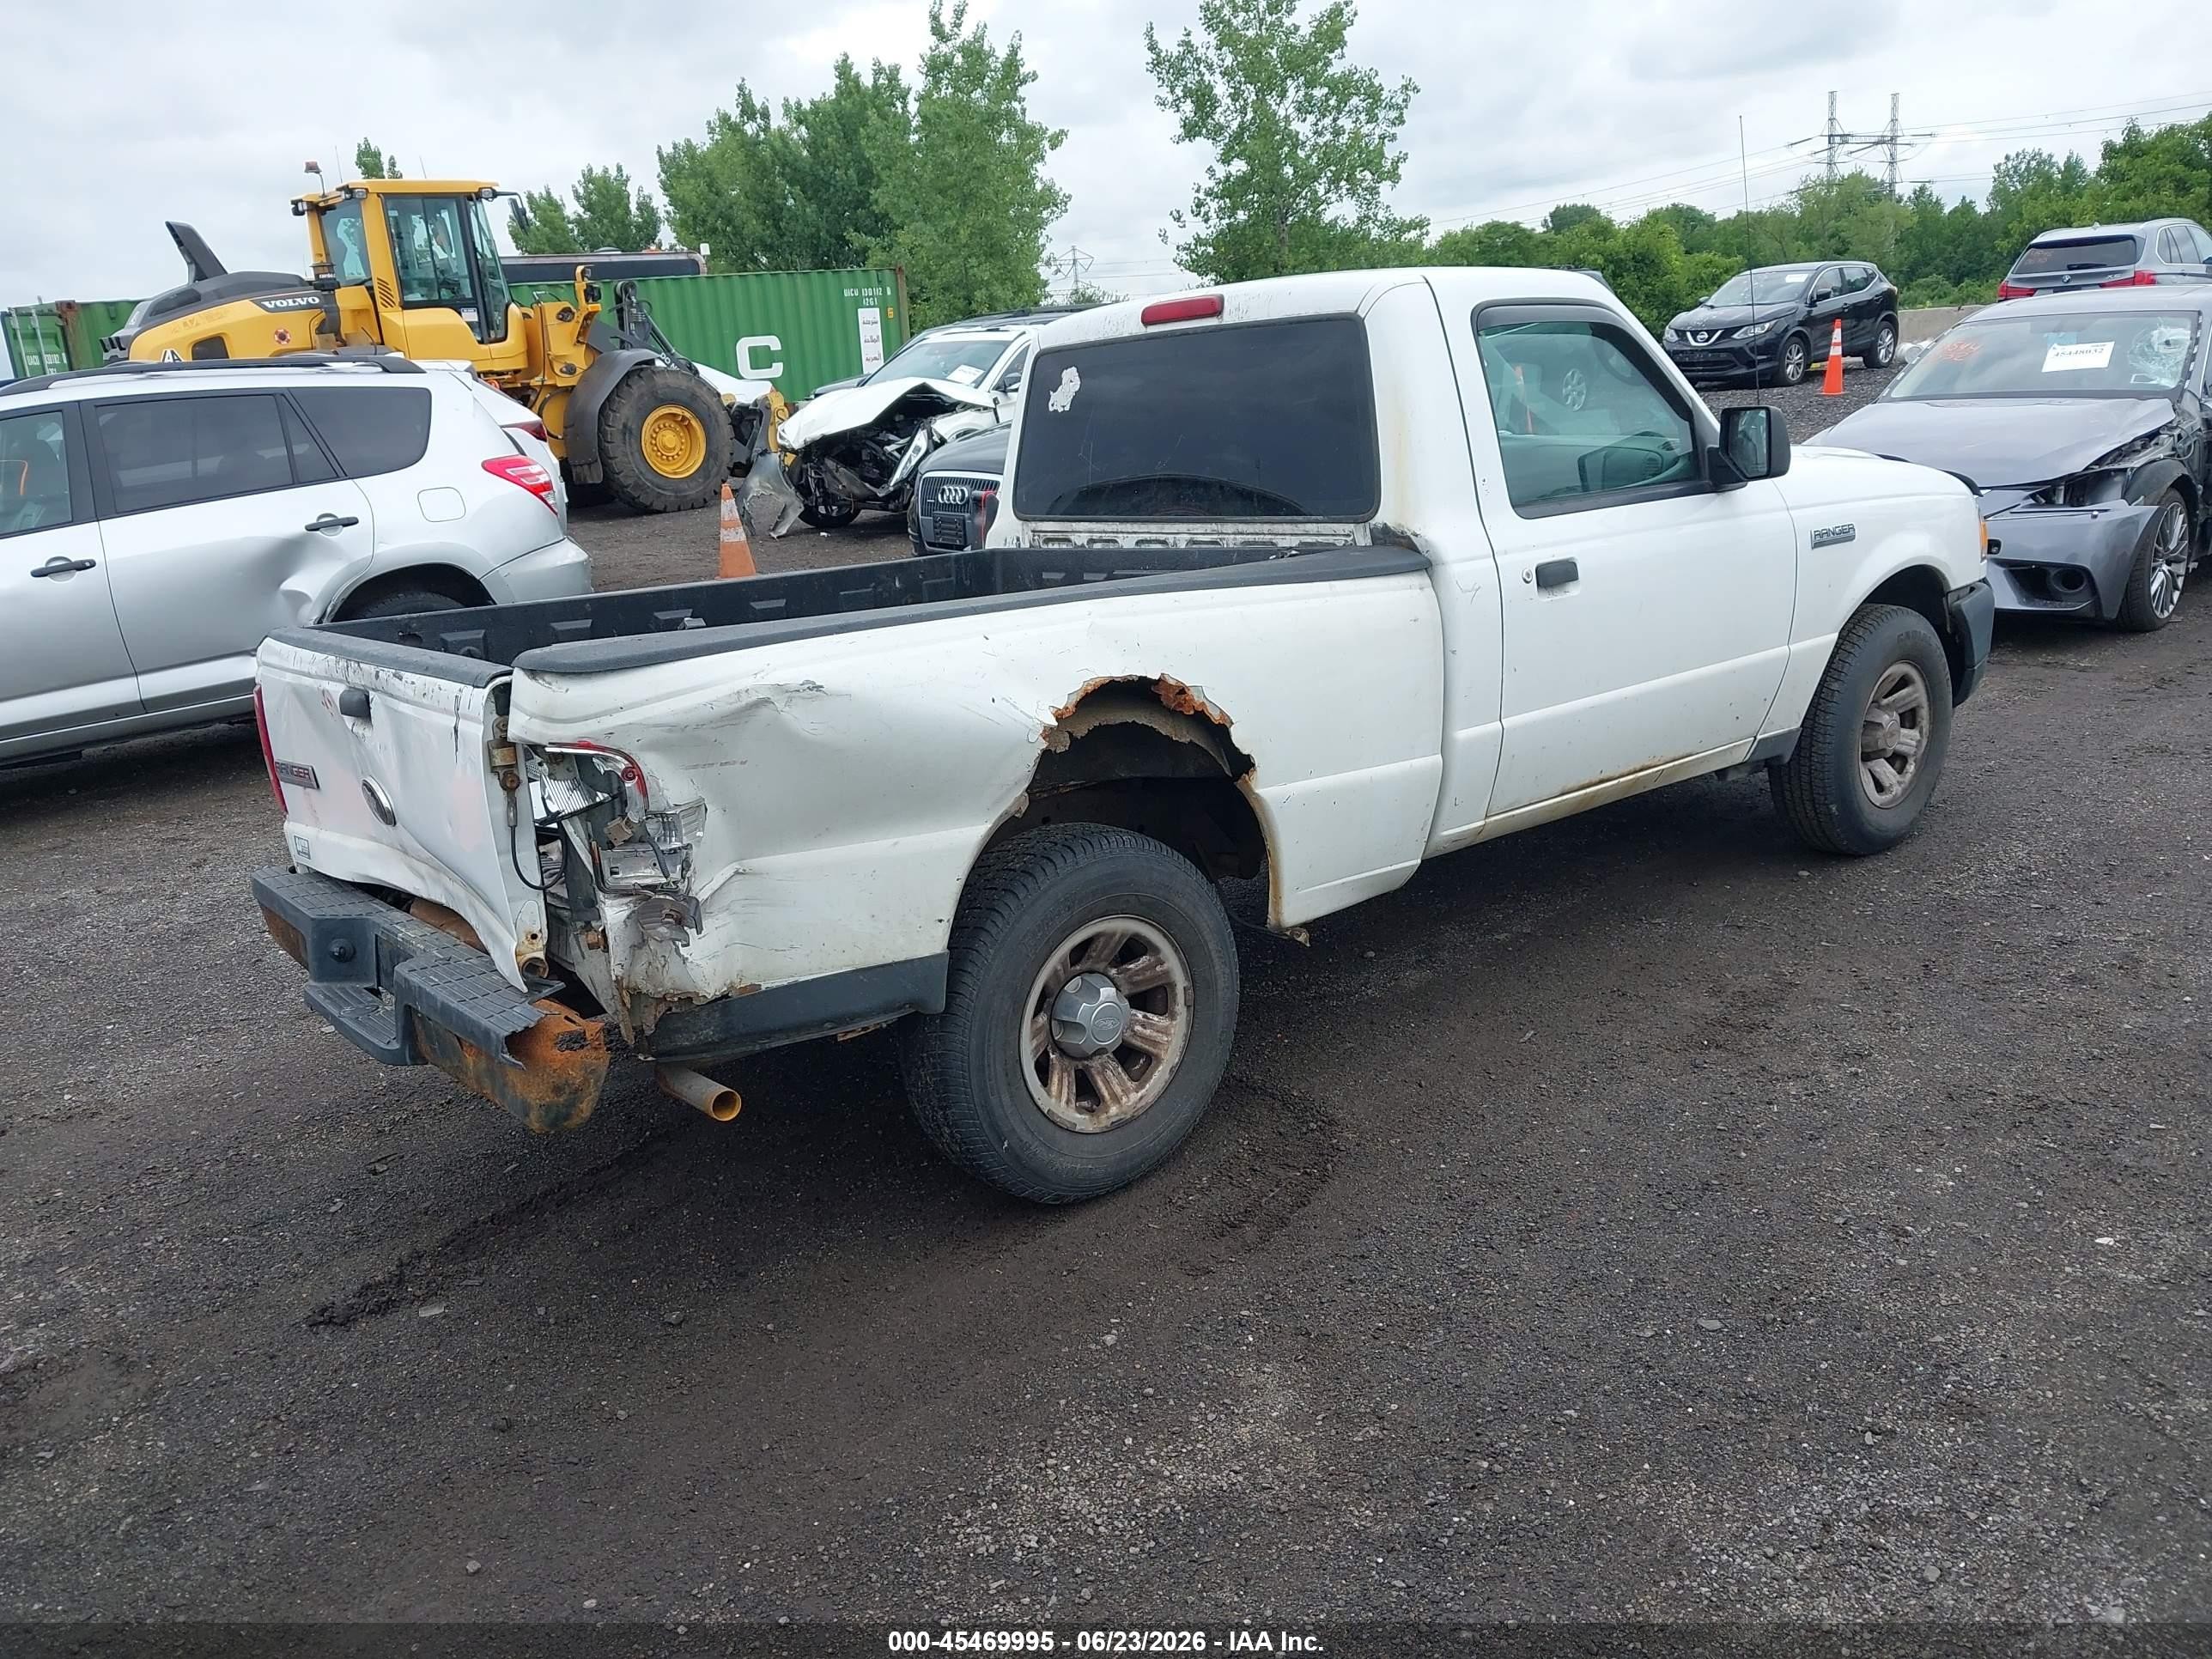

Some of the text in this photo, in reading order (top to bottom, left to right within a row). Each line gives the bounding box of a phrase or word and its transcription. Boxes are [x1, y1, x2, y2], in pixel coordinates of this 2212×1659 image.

[261, 296, 319, 308] VOLVO
[736, 336, 783, 379] C
[1813, 523, 1856, 540] RANGER
